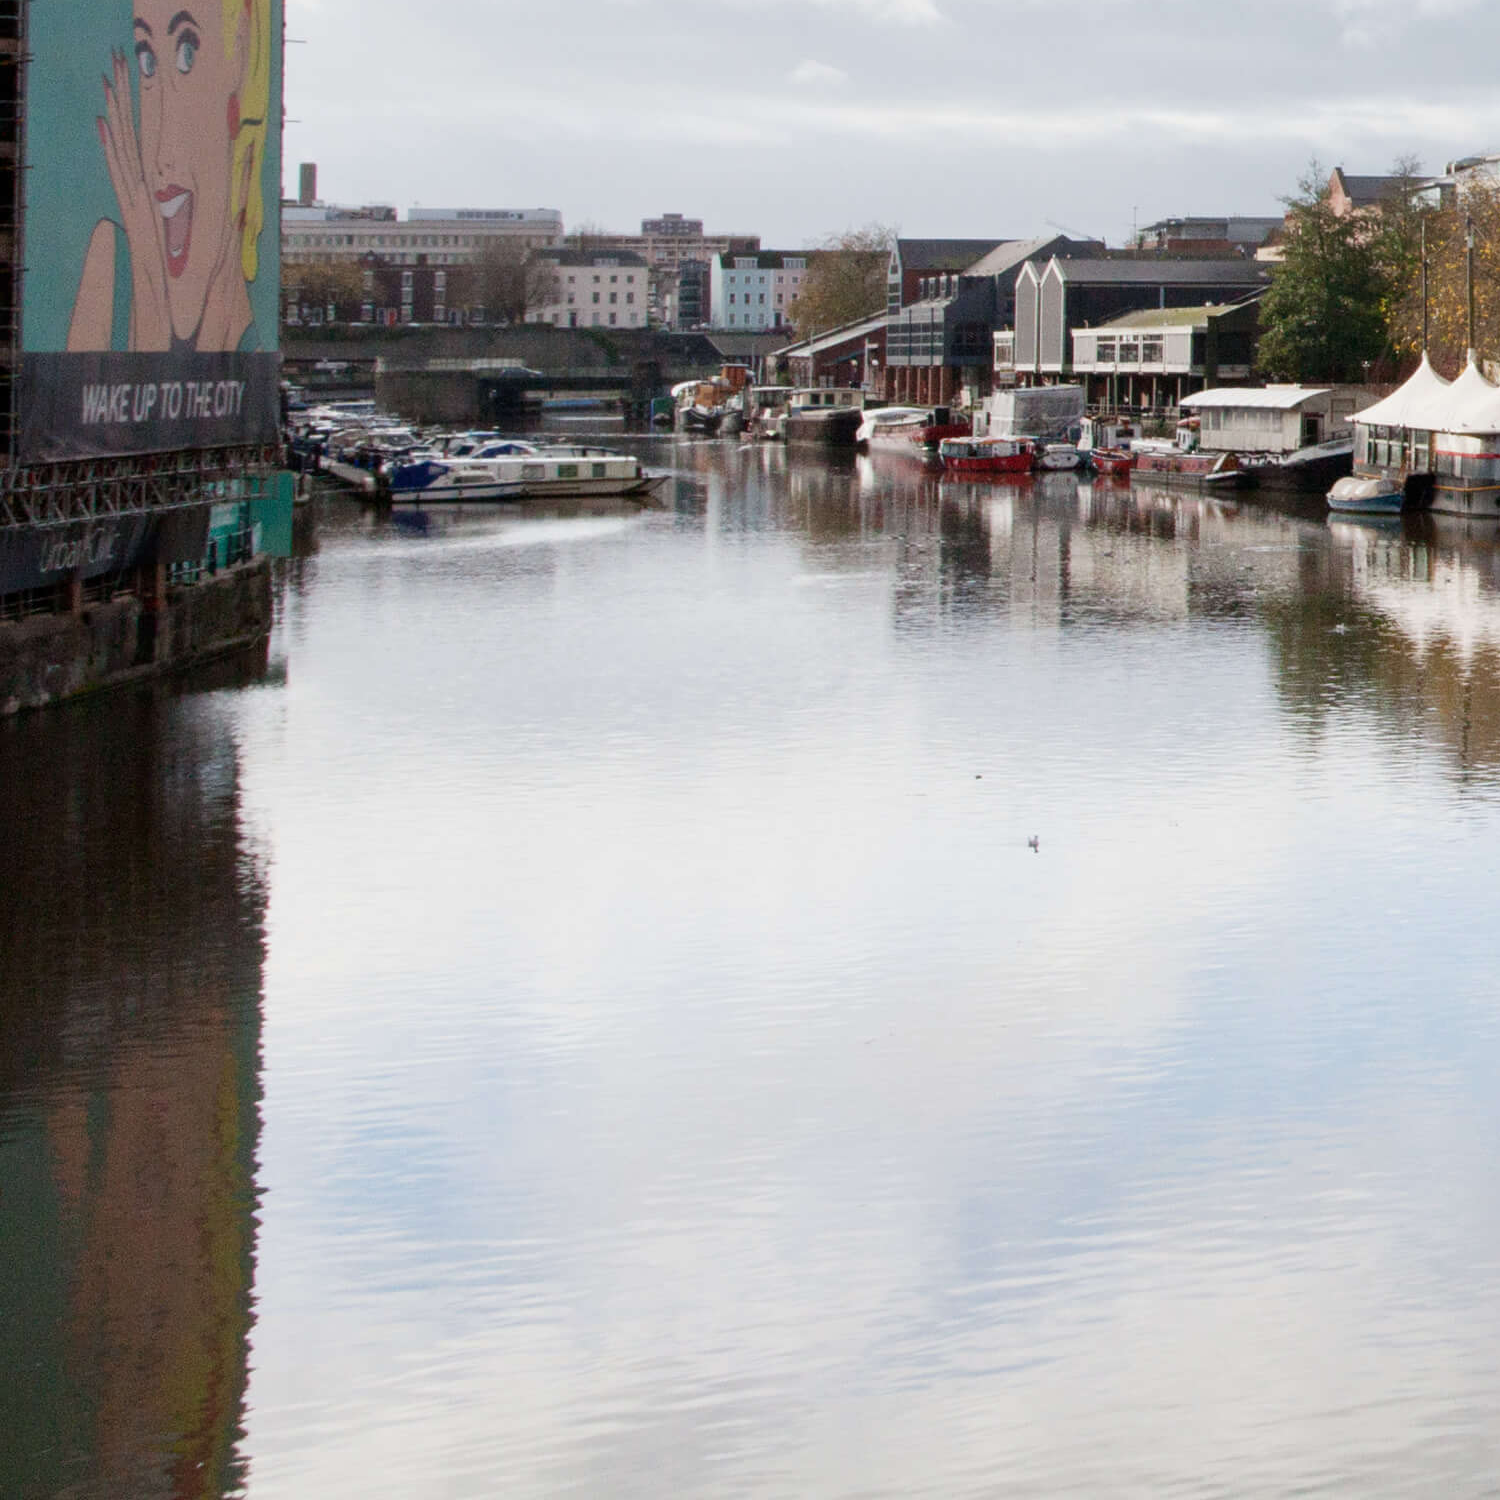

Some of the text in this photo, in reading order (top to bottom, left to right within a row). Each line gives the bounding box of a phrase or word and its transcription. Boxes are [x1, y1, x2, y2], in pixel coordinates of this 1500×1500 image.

[82, 380, 247, 424] WAKE UP TO THE CITY
